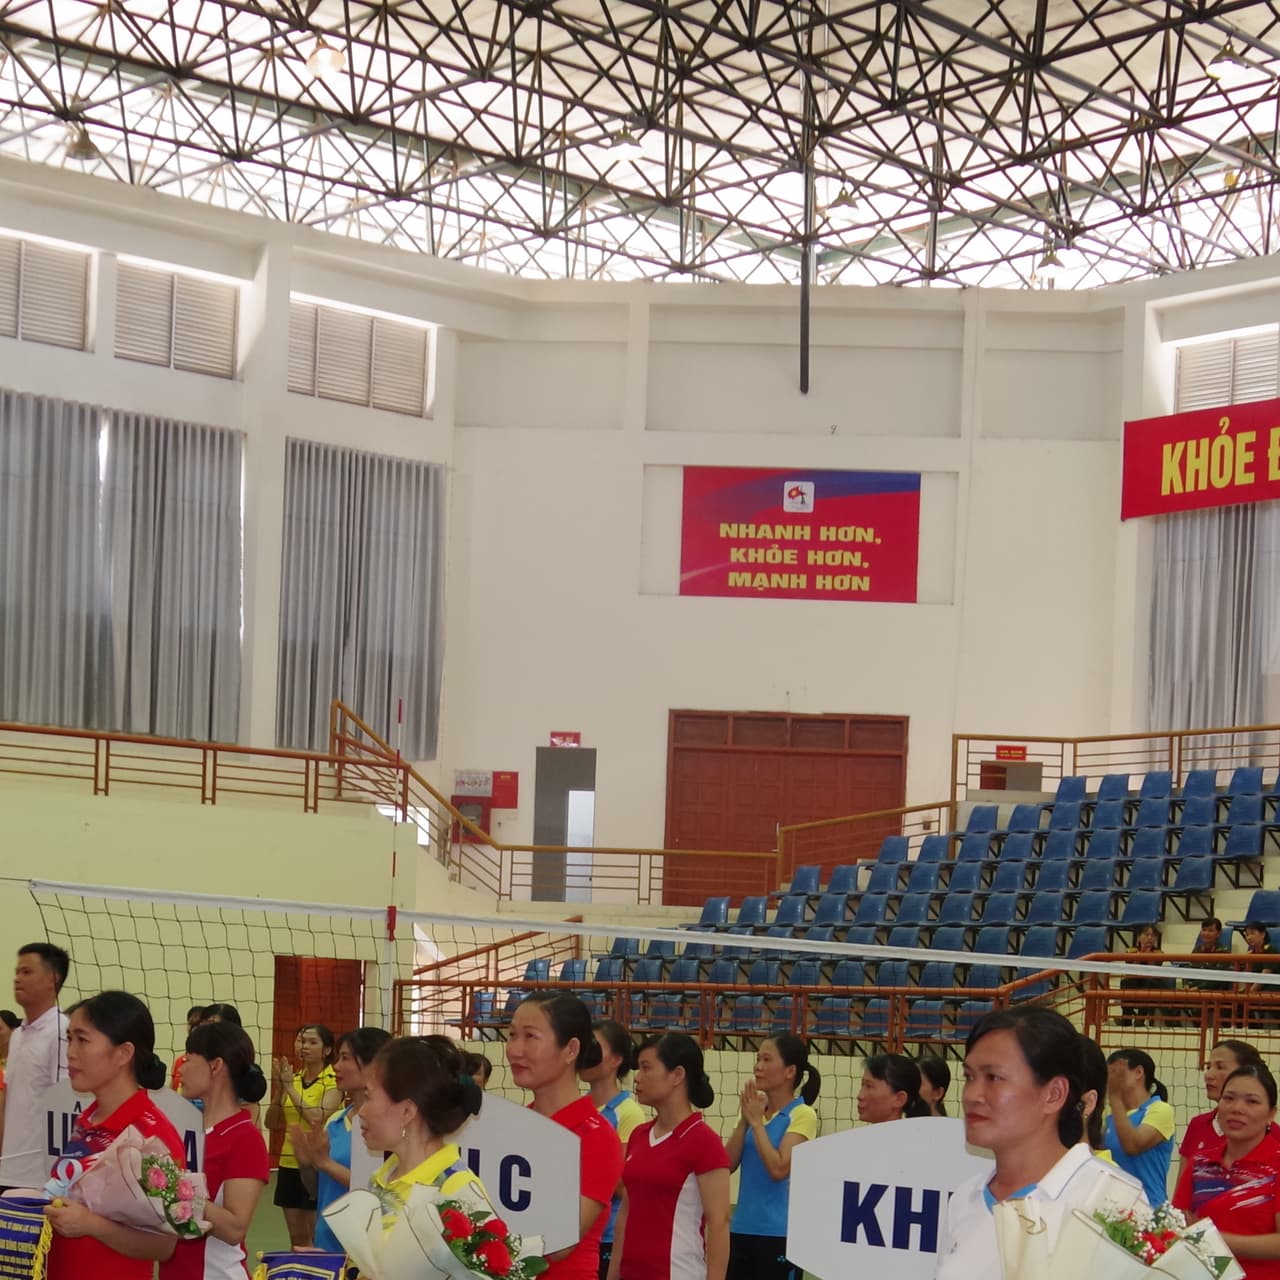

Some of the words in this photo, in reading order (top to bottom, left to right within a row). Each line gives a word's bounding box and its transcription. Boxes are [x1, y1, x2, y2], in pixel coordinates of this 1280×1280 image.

[1161, 416, 1256, 496] KHỎE
[719, 523, 811, 541] NHANH
[819, 525, 882, 545] HƠN,
[730, 544, 798, 565] KHỎE
[807, 549, 870, 569] HƠN,
[728, 571, 807, 591] MẠNH
[815, 574, 870, 592] HƠN
